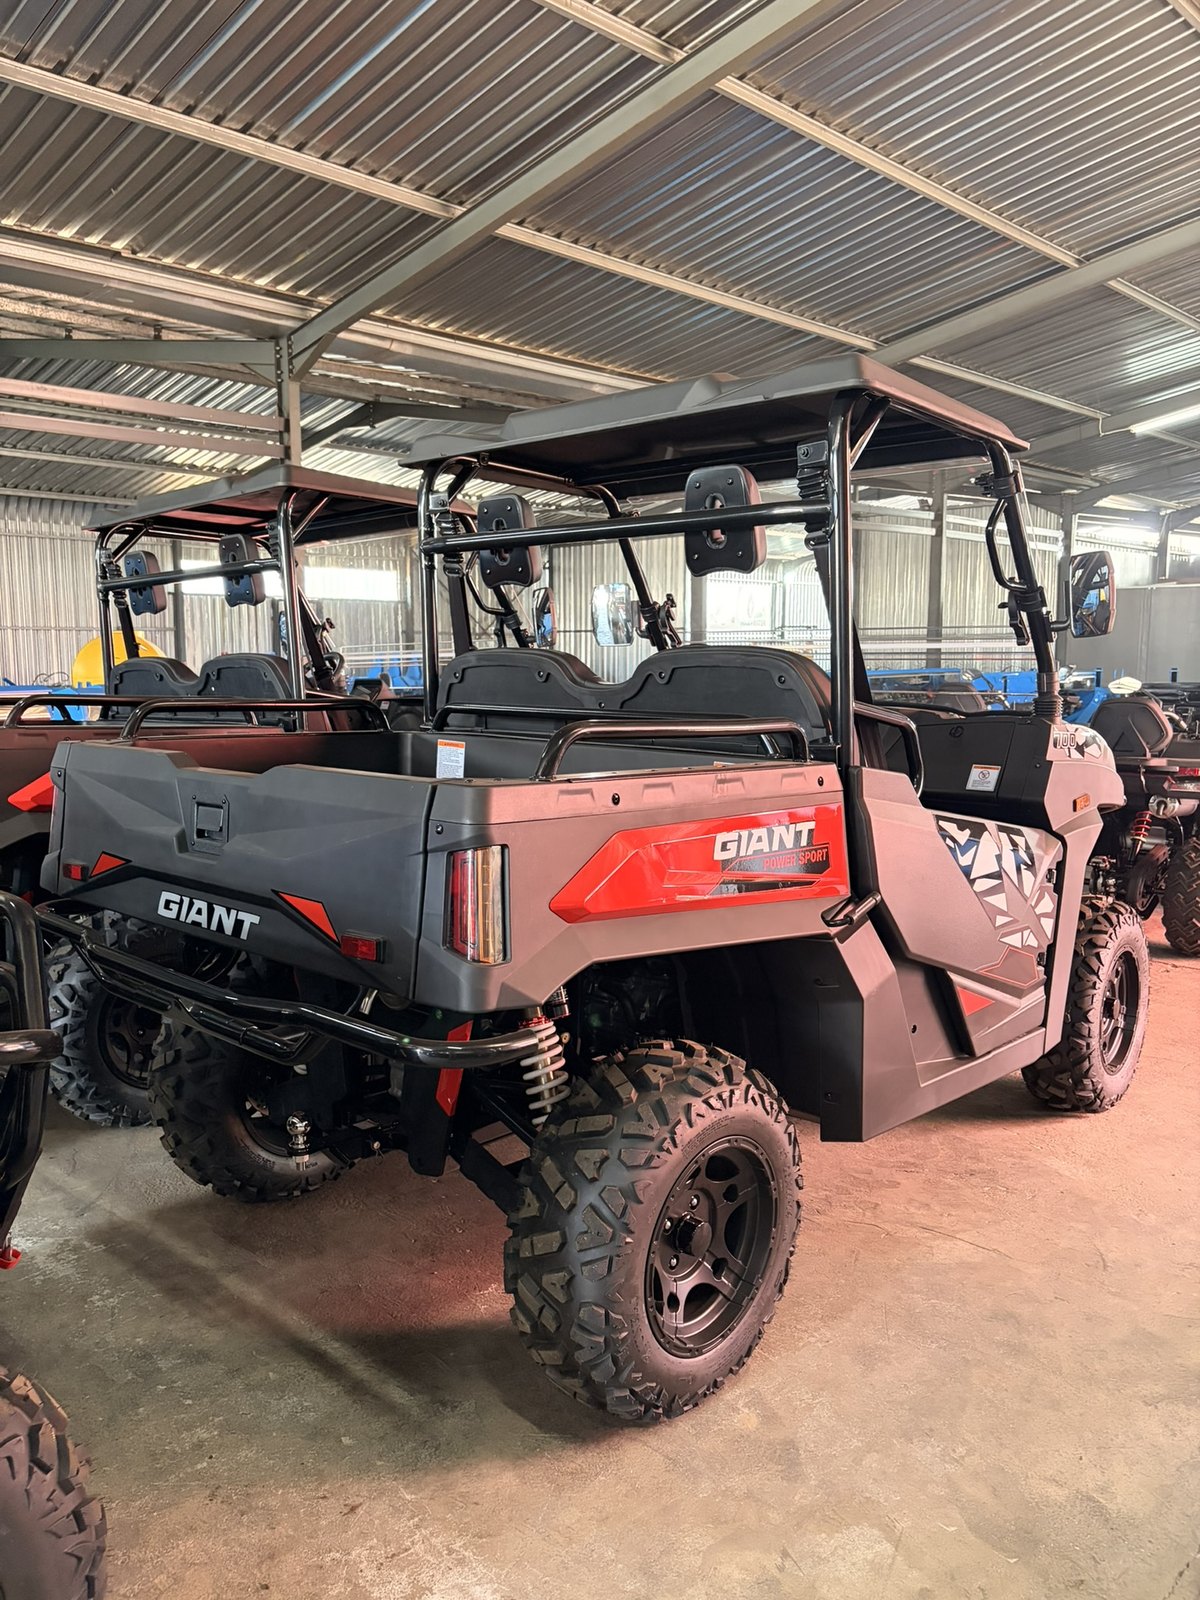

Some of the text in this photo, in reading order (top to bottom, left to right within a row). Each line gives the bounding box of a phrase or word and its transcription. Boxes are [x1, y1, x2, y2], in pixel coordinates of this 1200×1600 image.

[1053, 731, 1077, 749] 700
[713, 821, 816, 860] GIANT
[763, 849, 828, 870] POWER SPORT
[157, 891, 260, 940] GIANT
